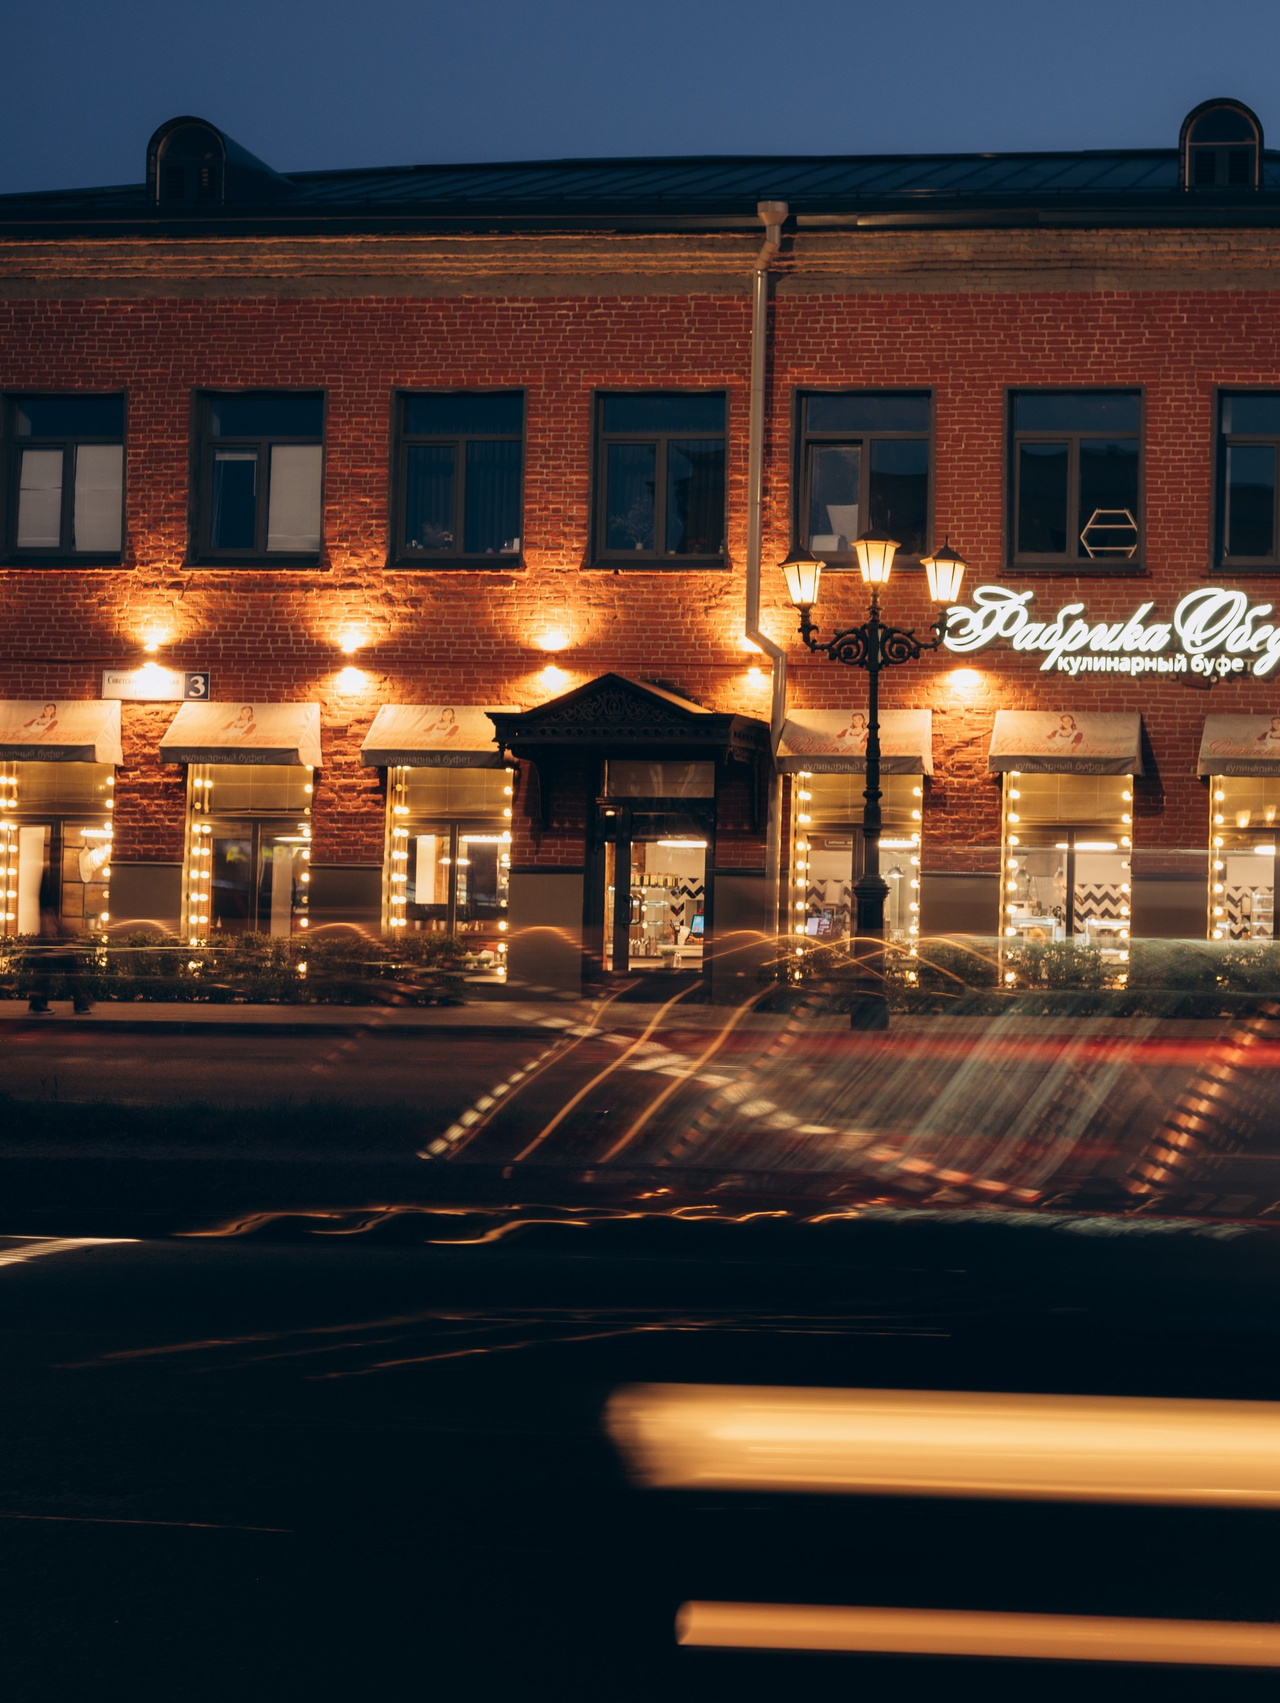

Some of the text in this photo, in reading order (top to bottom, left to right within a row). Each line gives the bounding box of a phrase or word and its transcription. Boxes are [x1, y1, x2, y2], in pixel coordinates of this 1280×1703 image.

[944, 585, 1173, 671] Фабрика
[1057, 654, 1255, 676] кулинарный буфет
[188, 675, 206, 697] 3
[802, 761, 860, 772] кулинарный
[1015, 761, 1073, 772] кулинарный
